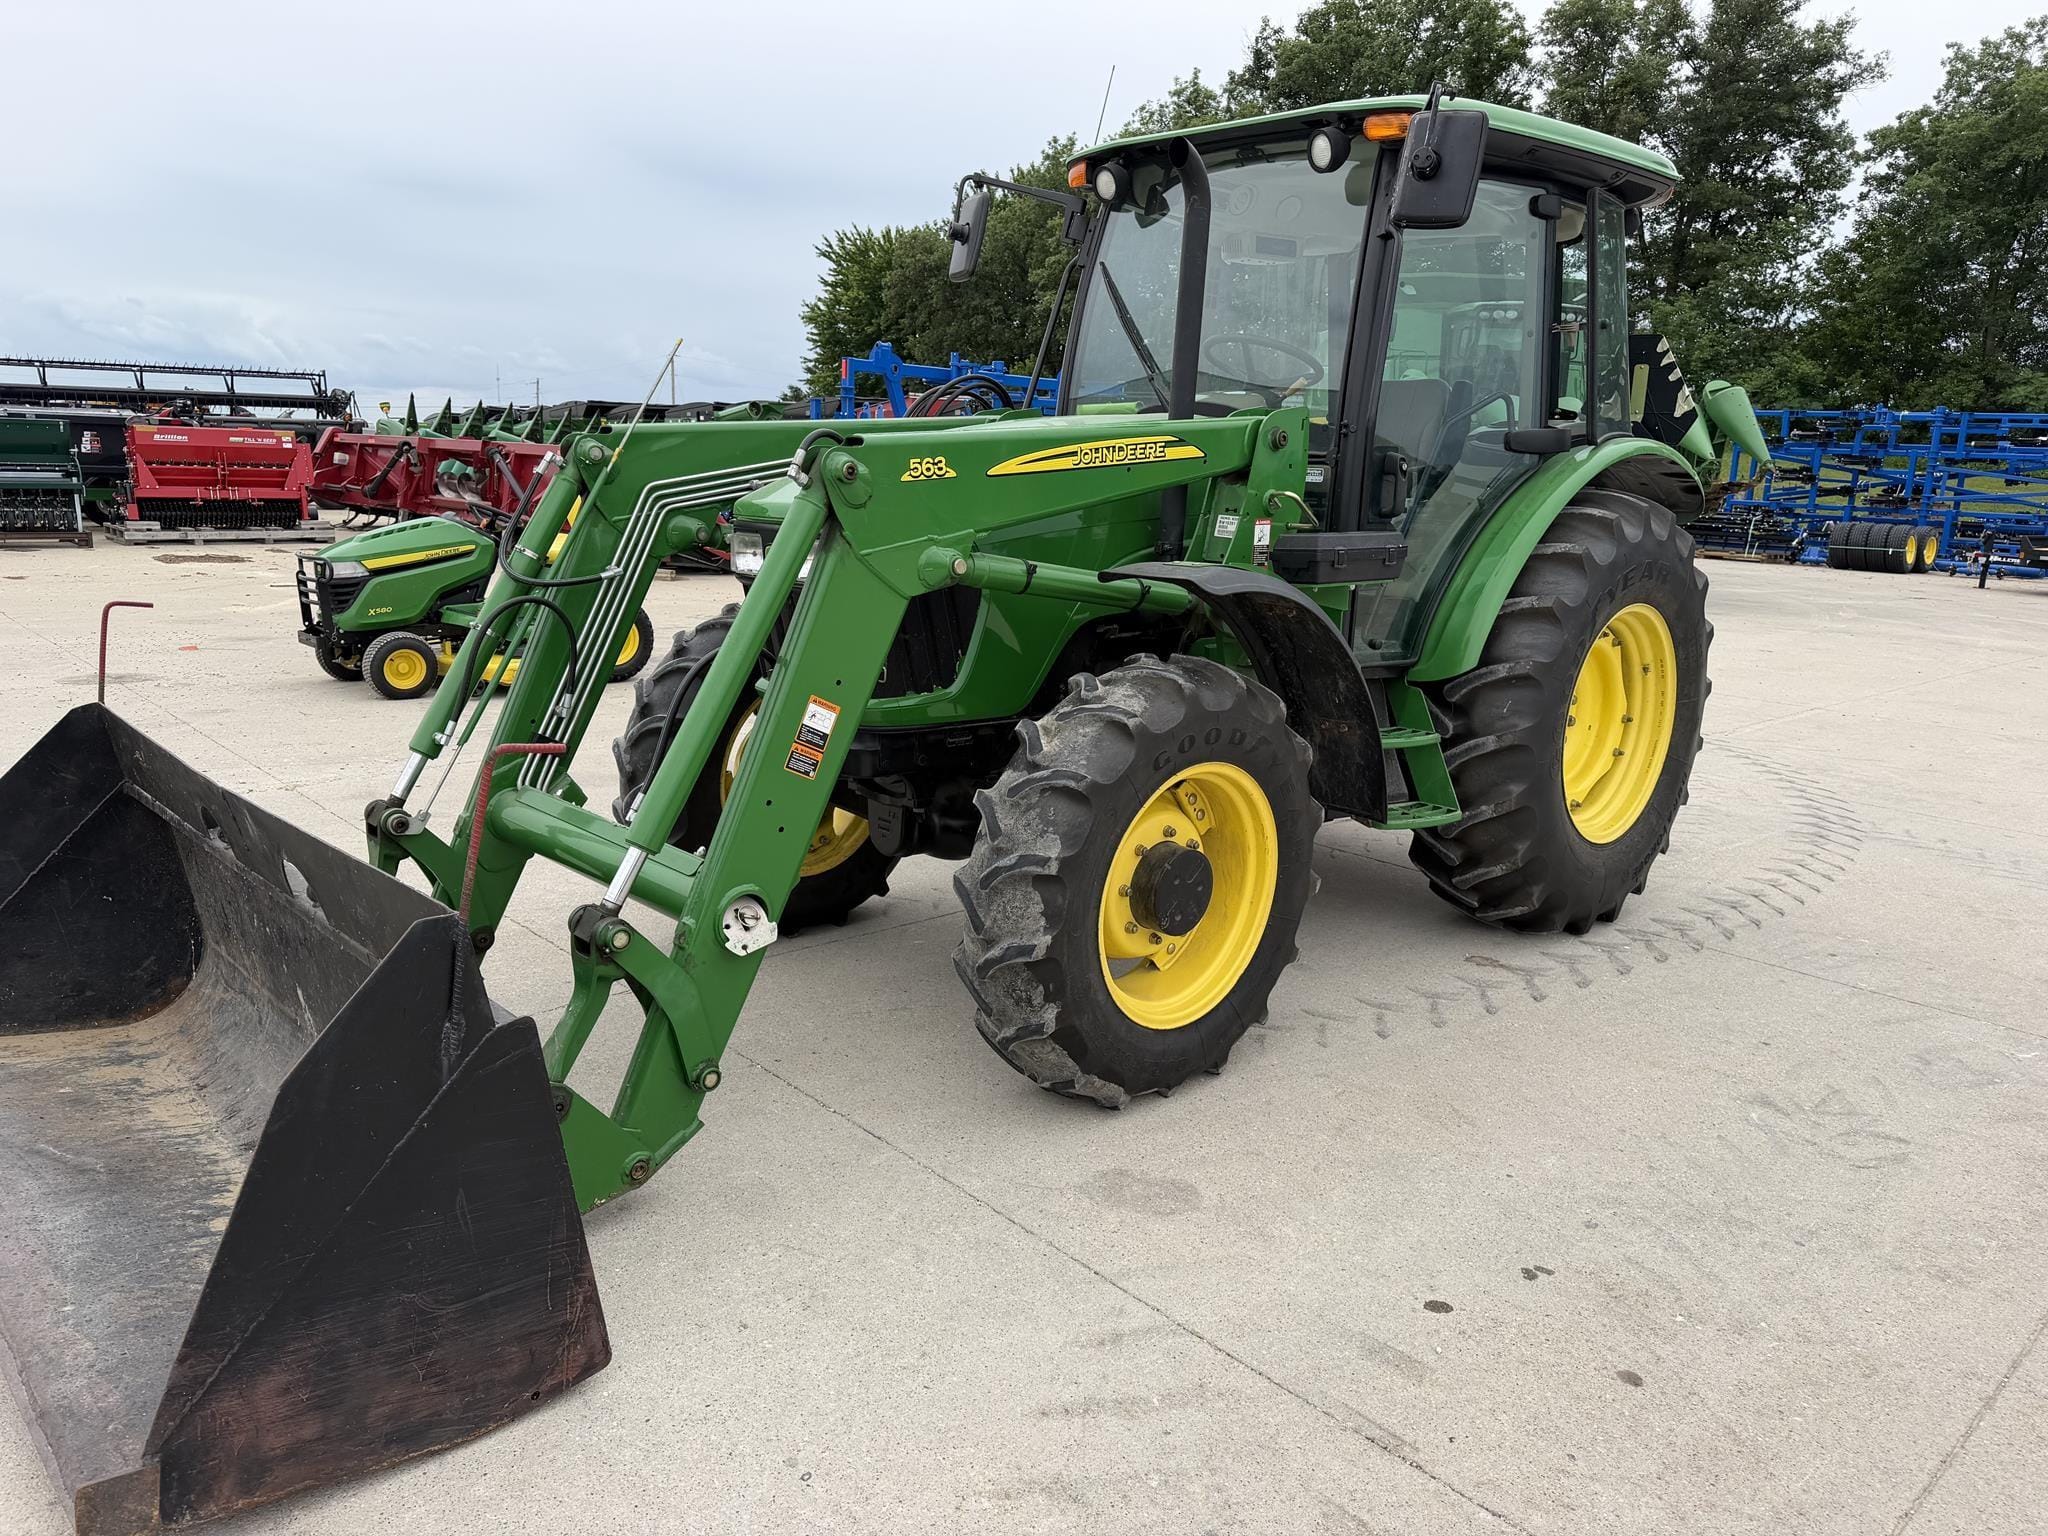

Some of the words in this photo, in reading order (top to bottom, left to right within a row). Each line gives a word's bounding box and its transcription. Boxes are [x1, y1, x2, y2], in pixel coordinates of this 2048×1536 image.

[1072, 446, 1115, 466] JOHN
[1113, 442, 1167, 461] DEERE
[909, 456, 948, 478] 563
[441, 547, 461, 555] DEERE
[367, 606, 393, 616] X580
